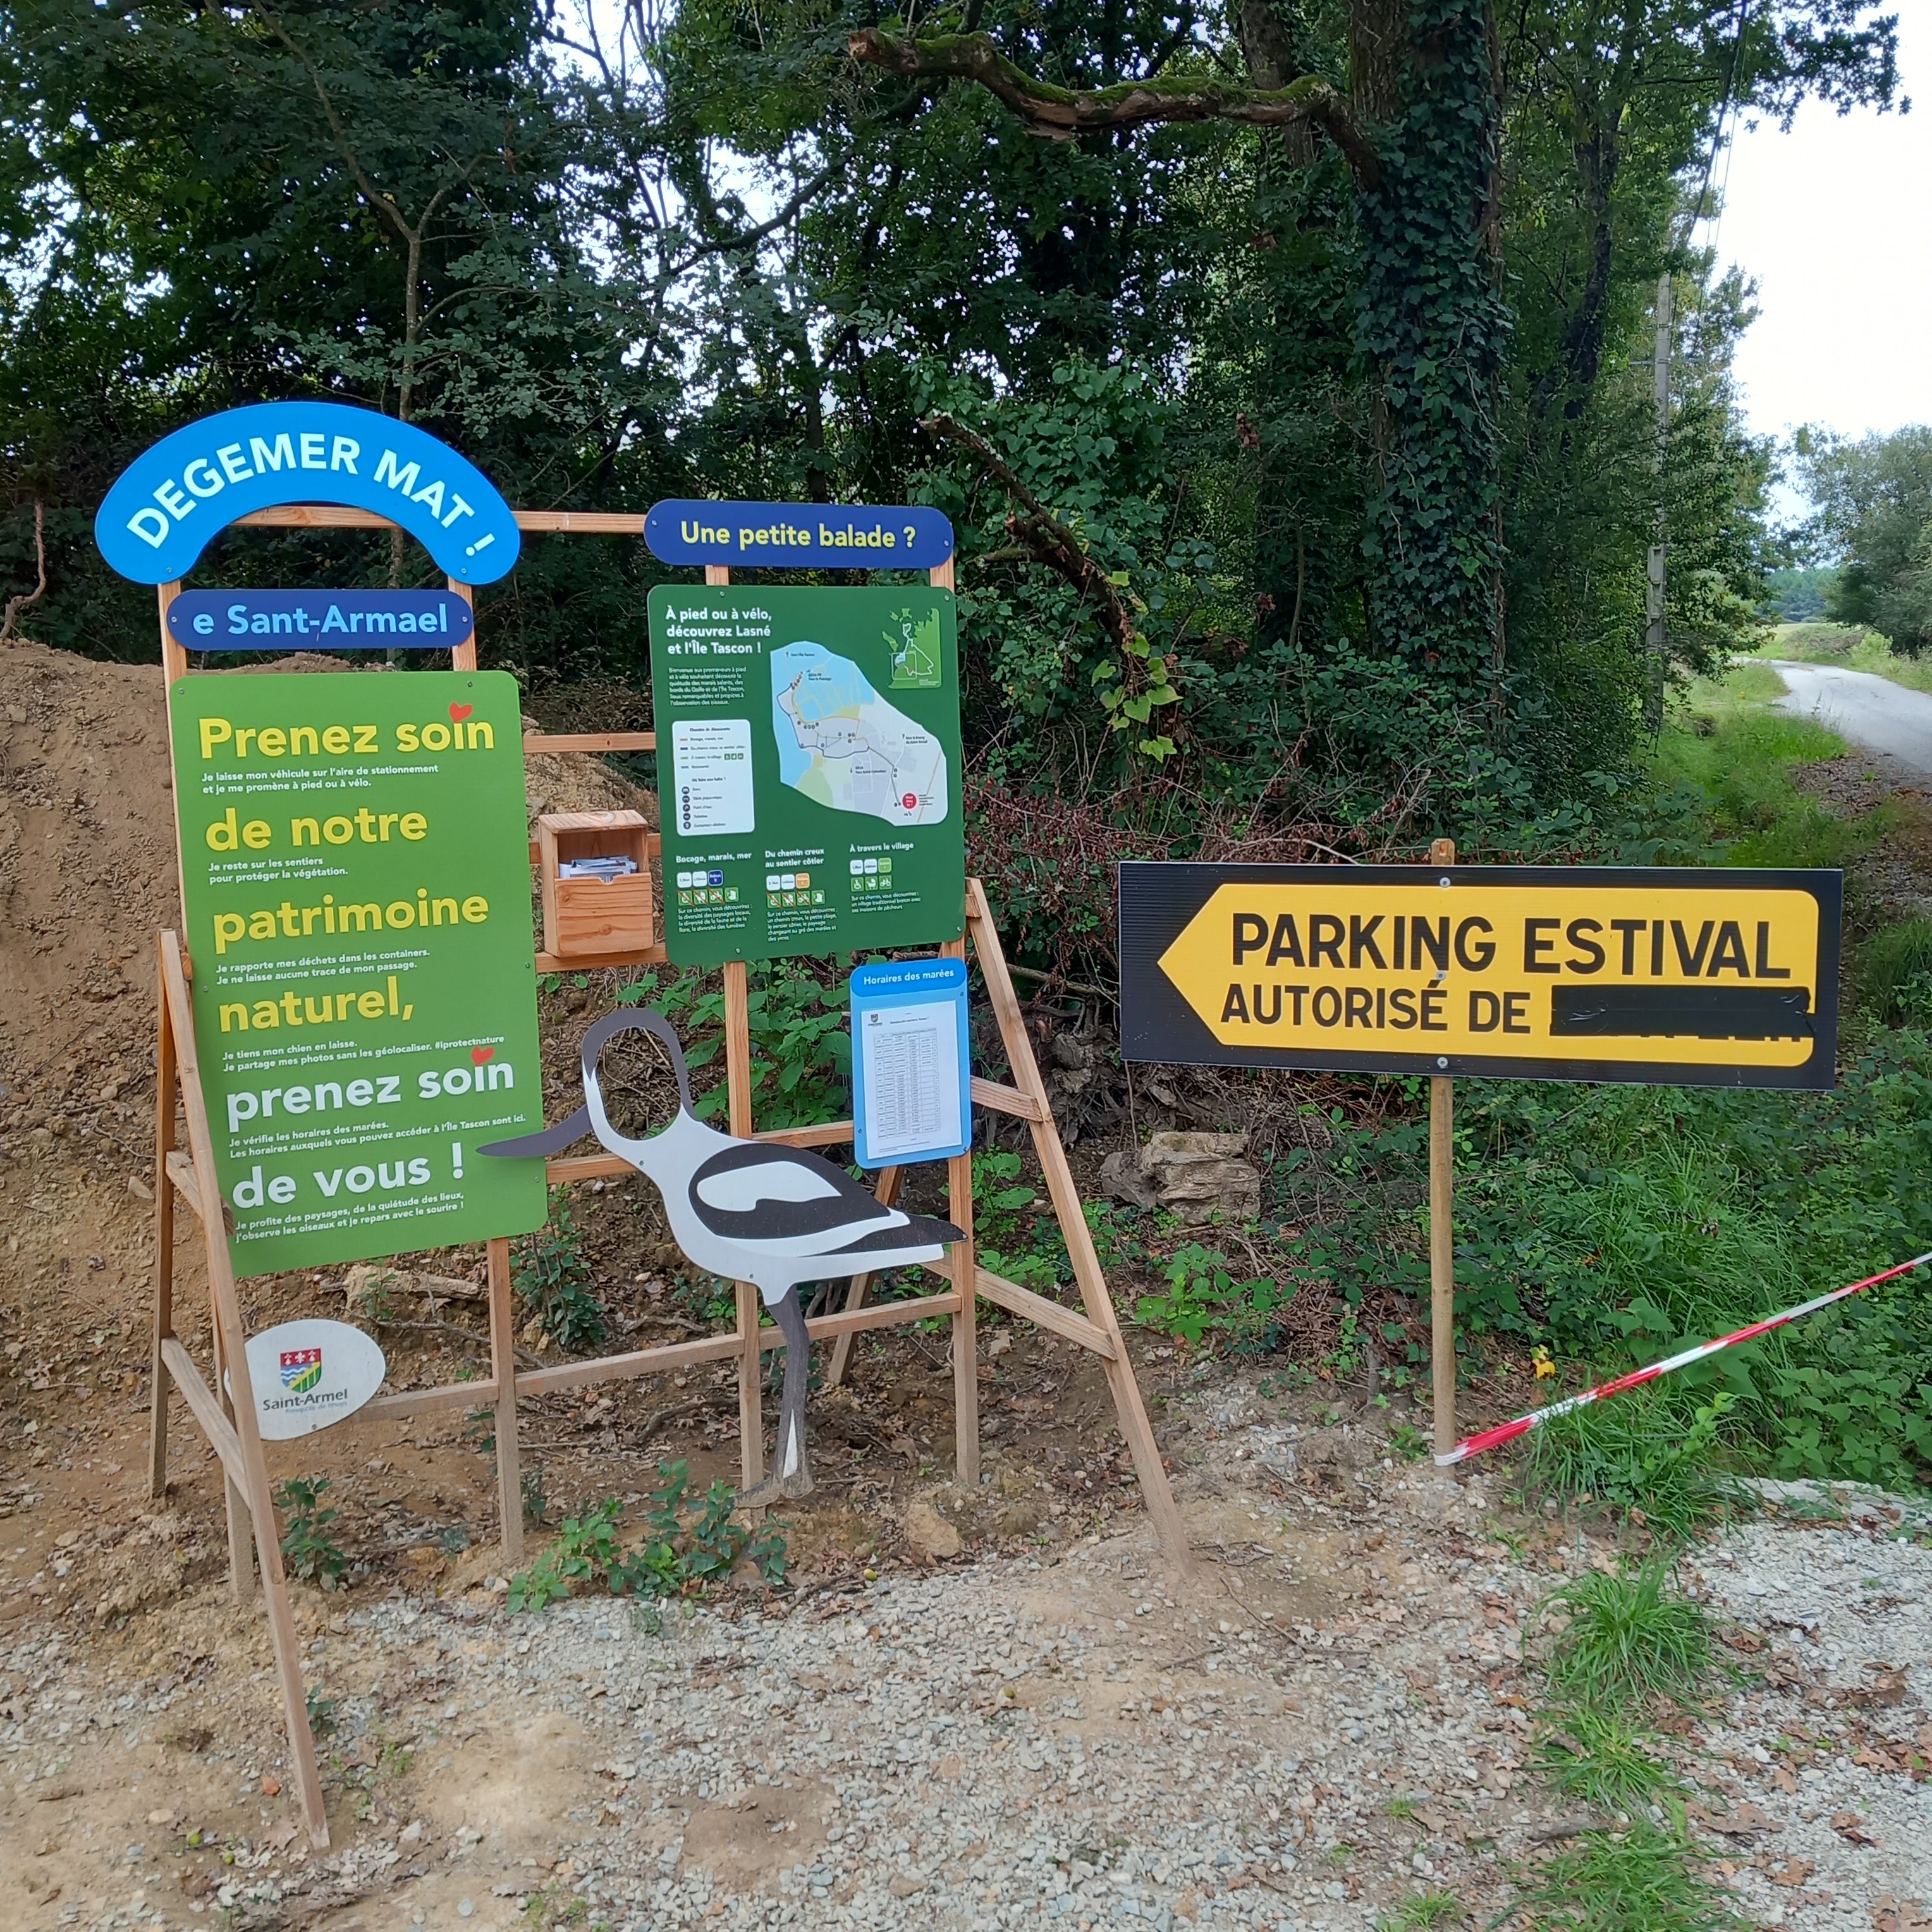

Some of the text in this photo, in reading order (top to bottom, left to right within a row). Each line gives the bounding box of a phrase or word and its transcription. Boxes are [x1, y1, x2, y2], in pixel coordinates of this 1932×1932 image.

[126, 432, 495, 556] DEGEMER MAT !
[681, 521, 915, 551] Une petite balade ?
[193, 604, 448, 634] e Sant-Armael
[666, 605, 772, 623] À pied ou à vélo,
[667, 625, 771, 637] découvrez Lasné
[668, 640, 761, 654] et l'Île Tascon !
[199, 718, 494, 759] Prenez soin
[202, 773, 213, 781] Je
[216, 772, 243, 781] laisse
[246, 772, 267, 780] mon
[271, 769, 309, 779] véhicule
[330, 767, 353, 776] l'aire
[357, 766, 368, 775] de
[371, 765, 439, 774] stationnement
[216, 784, 224, 795] je
[228, 784, 243, 792] me
[246, 782, 290, 793] promène
[293, 779, 298, 790] à
[301, 780, 322, 791] pied
[325, 780, 337, 788] ou
[340, 779, 346, 788] à
[348, 778, 372, 787] vélo.
[205, 807, 427, 852] de notre
[676, 855, 706, 864] Bocage,
[708, 853, 735, 861] marais,
[850, 844, 855, 852] À
[857, 843, 881, 851] travers
[208, 857, 323, 872] Je reste sur les sentiers
[209, 867, 348, 885] pour protéger la végétation.
[213, 888, 489, 954] patrimoine
[1232, 913, 1791, 978] PARKING ESTIVAL
[216, 964, 227, 973] Je
[230, 961, 273, 973] rapporte
[276, 959, 296, 968] mes
[299, 957, 336, 966] déchets
[339, 953, 361, 963] dans
[379, 949, 430, 960] containers.
[217, 962, 417, 985] Je ne laisse aucune trace de mon passage.
[864, 969, 954, 985] Horaires des marées
[219, 975, 413, 1032] naturel,
[1220, 979, 1448, 1031] AUTORISÉ
[1469, 991, 1531, 1034] DE
[223, 1052, 233, 1060] Je
[237, 1050, 260, 1059] tiens
[263, 1048, 284, 1056] mon
[287, 1045, 312, 1055] chien
[329, 1040, 357, 1049] laisse.
[223, 1036, 504, 1072] Je partage mes photos sans les géolocaliser. #iprotectnature
[226, 1063, 513, 1133] prenez soin
[229, 1139, 240, 1147] Je
[243, 1136, 274, 1146] vérifie
[292, 1130, 331, 1140] horaires
[333, 1125, 350, 1134] des
[353, 1121, 389, 1132] marées.
[230, 1150, 247, 1158] Les
[249, 1146, 288, 1156] horaires
[290, 1141, 333, 1151] auxquels
[360, 1133, 393, 1144] pouvez
[396, 1127, 431, 1137] accéder
[434, 1125, 439, 1133] à
[442, 1122, 457, 1132] l'Île
[460, 1119, 489, 1129] Tascon
[492, 1116, 511, 1125] sont
[513, 1114, 526, 1122] ici.
[233, 1142, 463, 1209] de vous !
[236, 1232, 280, 1244] j'observe
[283, 1226, 296, 1235] les
[299, 1221, 334, 1232] oiseaux
[337, 1219, 347, 1227] et
[349, 1218, 358, 1228] je
[360, 1212, 390, 1225] repars
[393, 1210, 413, 1220] avec
[416, 1208, 424, 1216] le
[427, 1202, 457, 1214] sourire
[250, 1217, 282, 1230] profite
[285, 1214, 302, 1223] des
[305, 1208, 350, 1223] paysages,
[353, 1205, 365, 1213] de
[367, 1202, 376, 1212] la
[379, 1197, 419, 1211] quiétude
[422, 1195, 437, 1204] des
[440, 1192, 463, 1201] lieux,
[263, 1388, 347, 1410] Saint-Armel
